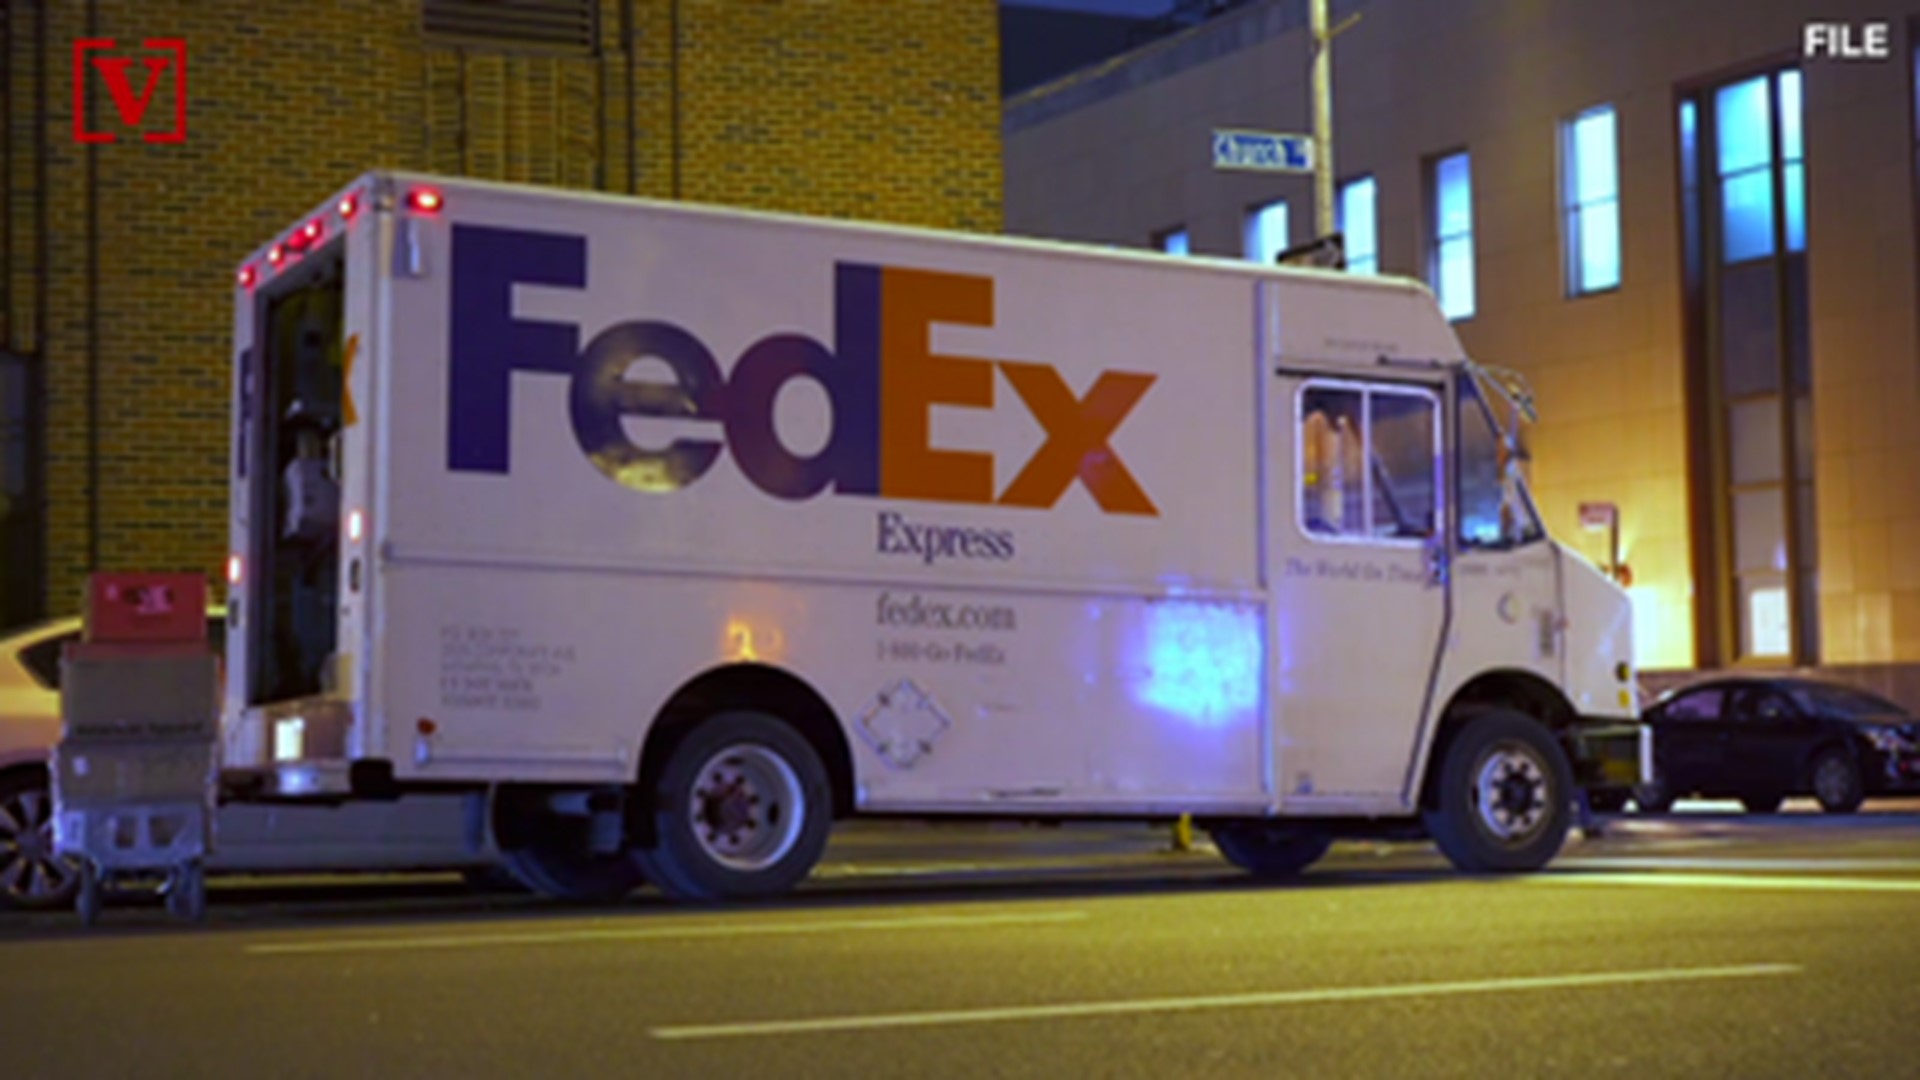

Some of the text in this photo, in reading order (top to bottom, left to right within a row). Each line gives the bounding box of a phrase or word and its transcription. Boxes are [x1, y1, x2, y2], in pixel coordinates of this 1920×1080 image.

[1213, 131, 1288, 168] Church
[447, 223, 1160, 518] FedEx
[877, 511, 1015, 564] Express
[876, 591, 1017, 630] fedex.com
